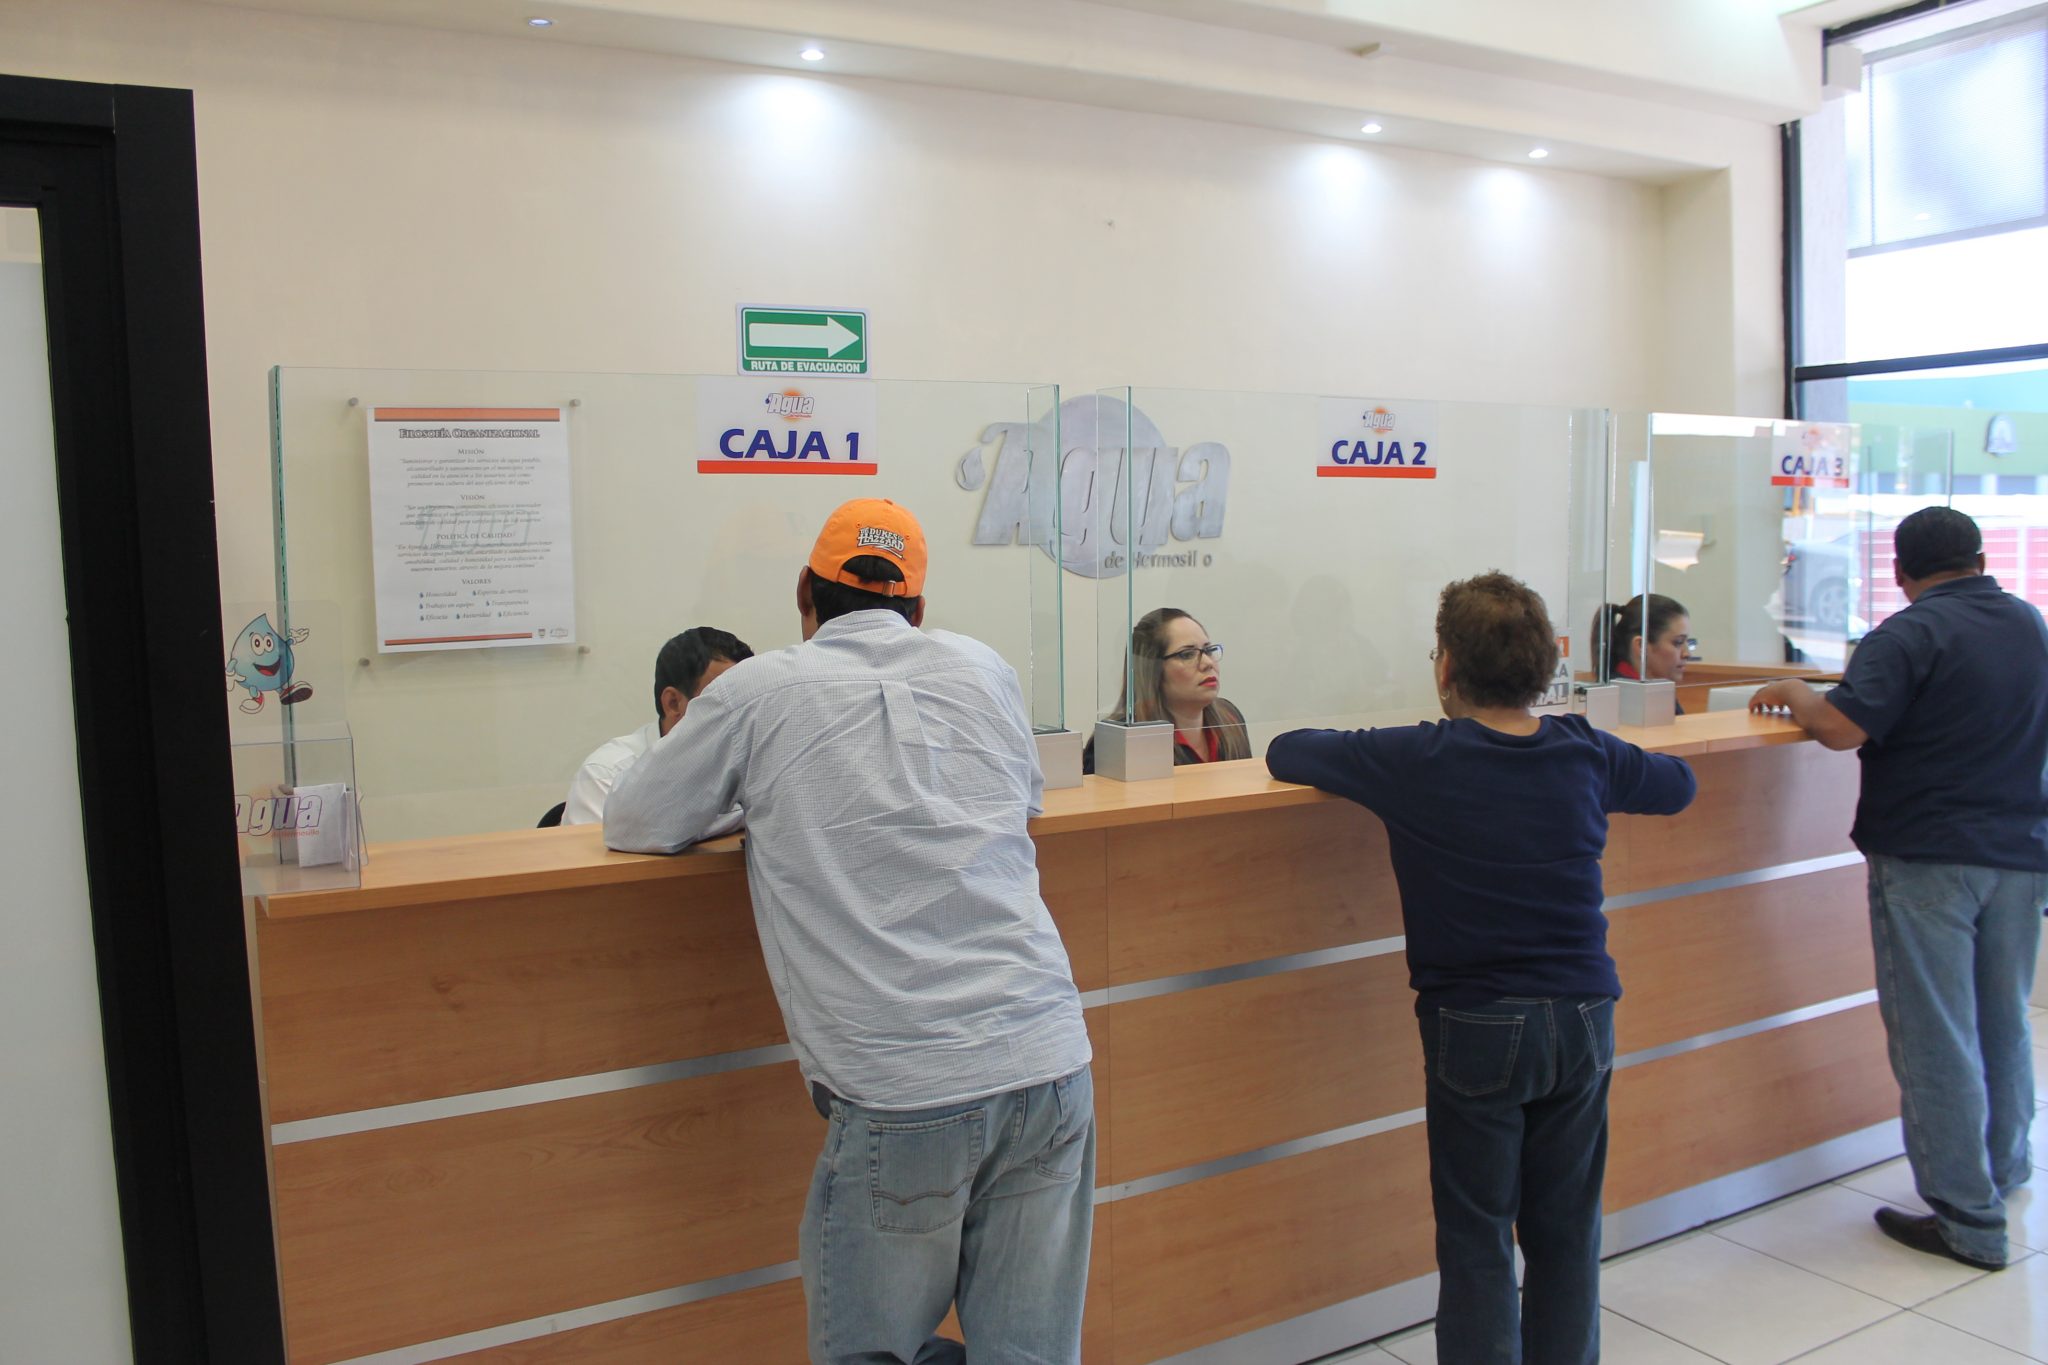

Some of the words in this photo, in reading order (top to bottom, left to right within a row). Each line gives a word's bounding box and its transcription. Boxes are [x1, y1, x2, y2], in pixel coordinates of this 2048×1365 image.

[751, 361, 779, 371] RUTA
[781, 361, 795, 372] DE
[797, 362, 861, 373] EVACUACION
[766, 392, 815, 416] Agua
[719, 428, 831, 460] CAJA
[845, 432, 860, 460] 1
[1331, 439, 1405, 465] CAJA
[1412, 441, 1427, 465] 2
[1781, 454, 1829, 476] CAJA
[1833, 457, 1844, 477] 3
[857, 531, 905, 552] HAZZARD
[869, 528, 899, 541] DUKES
[1104, 550, 1125, 569] de
